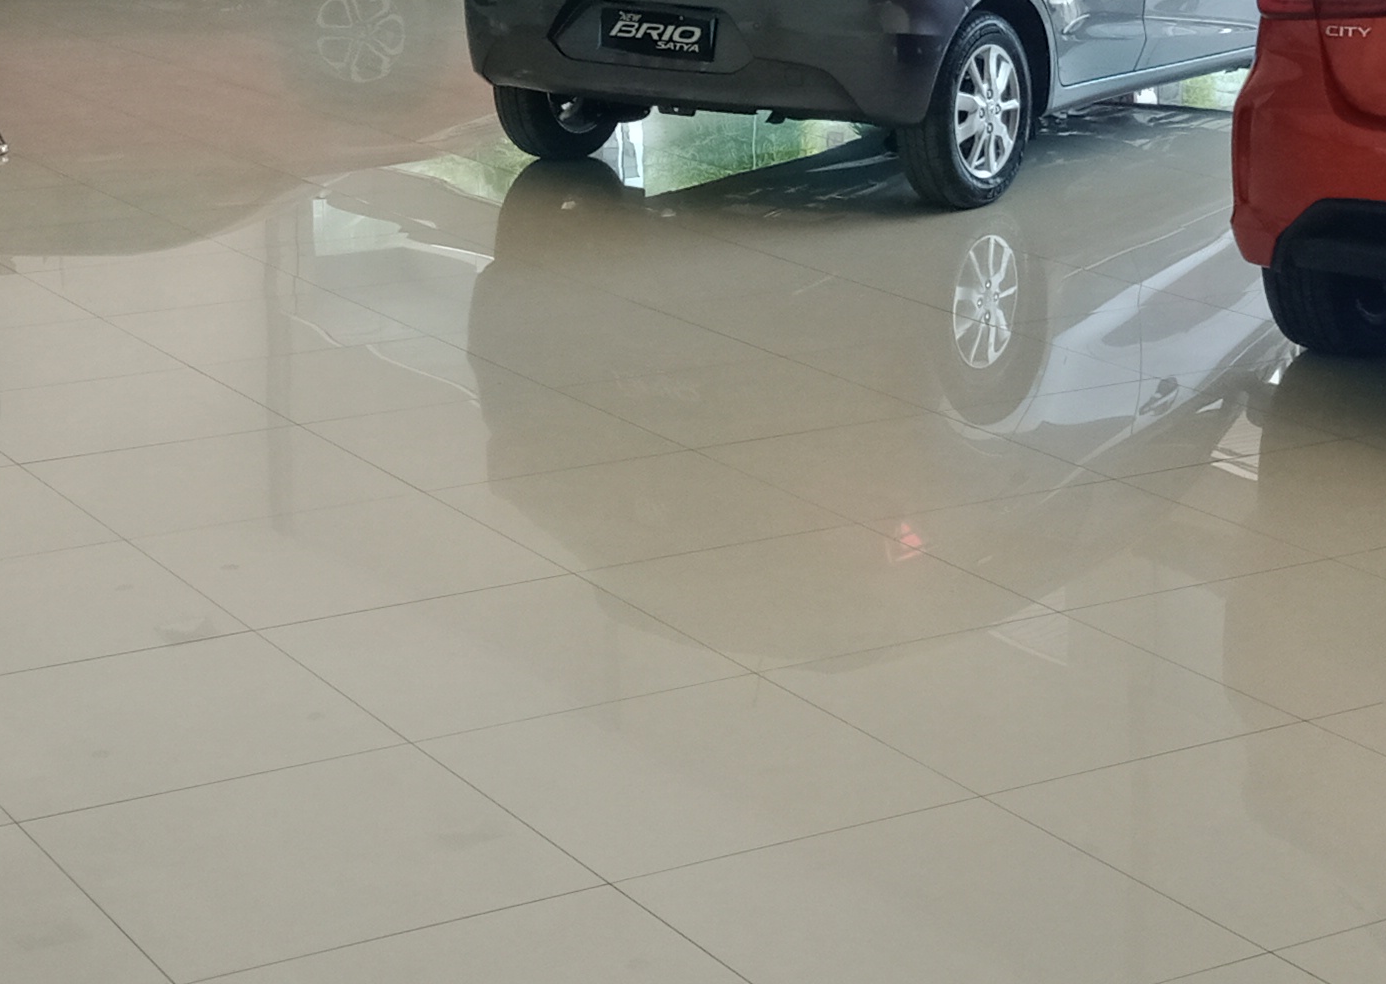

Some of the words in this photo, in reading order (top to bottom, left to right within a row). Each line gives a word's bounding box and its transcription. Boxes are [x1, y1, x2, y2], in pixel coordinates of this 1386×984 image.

[619, 10, 642, 22] NEW
[609, 20, 702, 44] BRIO
[1325, 25, 1372, 37] CITY
[655, 40, 700, 54] SATYA
